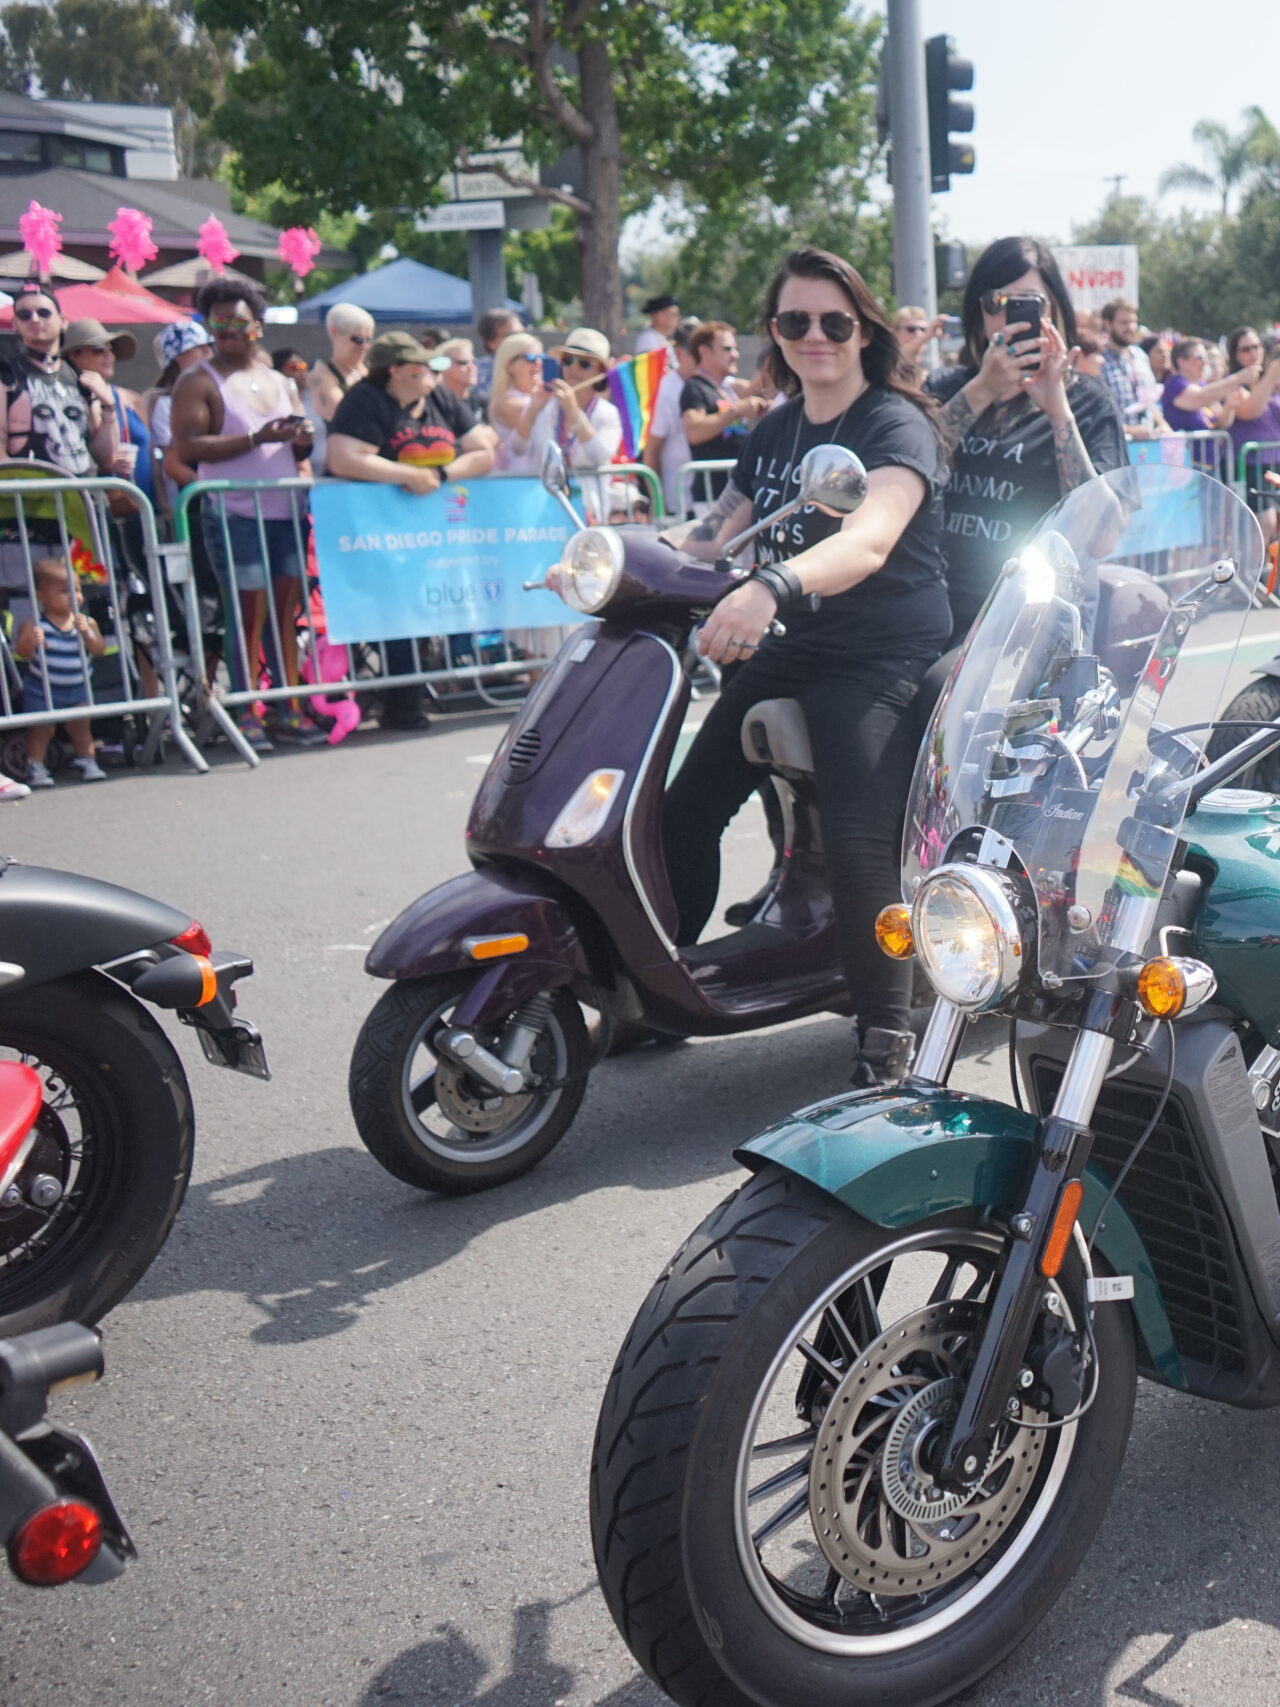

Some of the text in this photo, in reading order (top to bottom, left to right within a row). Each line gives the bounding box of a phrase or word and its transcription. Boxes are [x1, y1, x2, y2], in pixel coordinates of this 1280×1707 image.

[1003, 442, 1024, 464] A
[755, 455, 763, 477] I
[339, 526, 567, 553] SAN DIEGO PRIDE PARADE
[425, 582, 477, 606] blue
[1043, 803, 1086, 821] Indian
